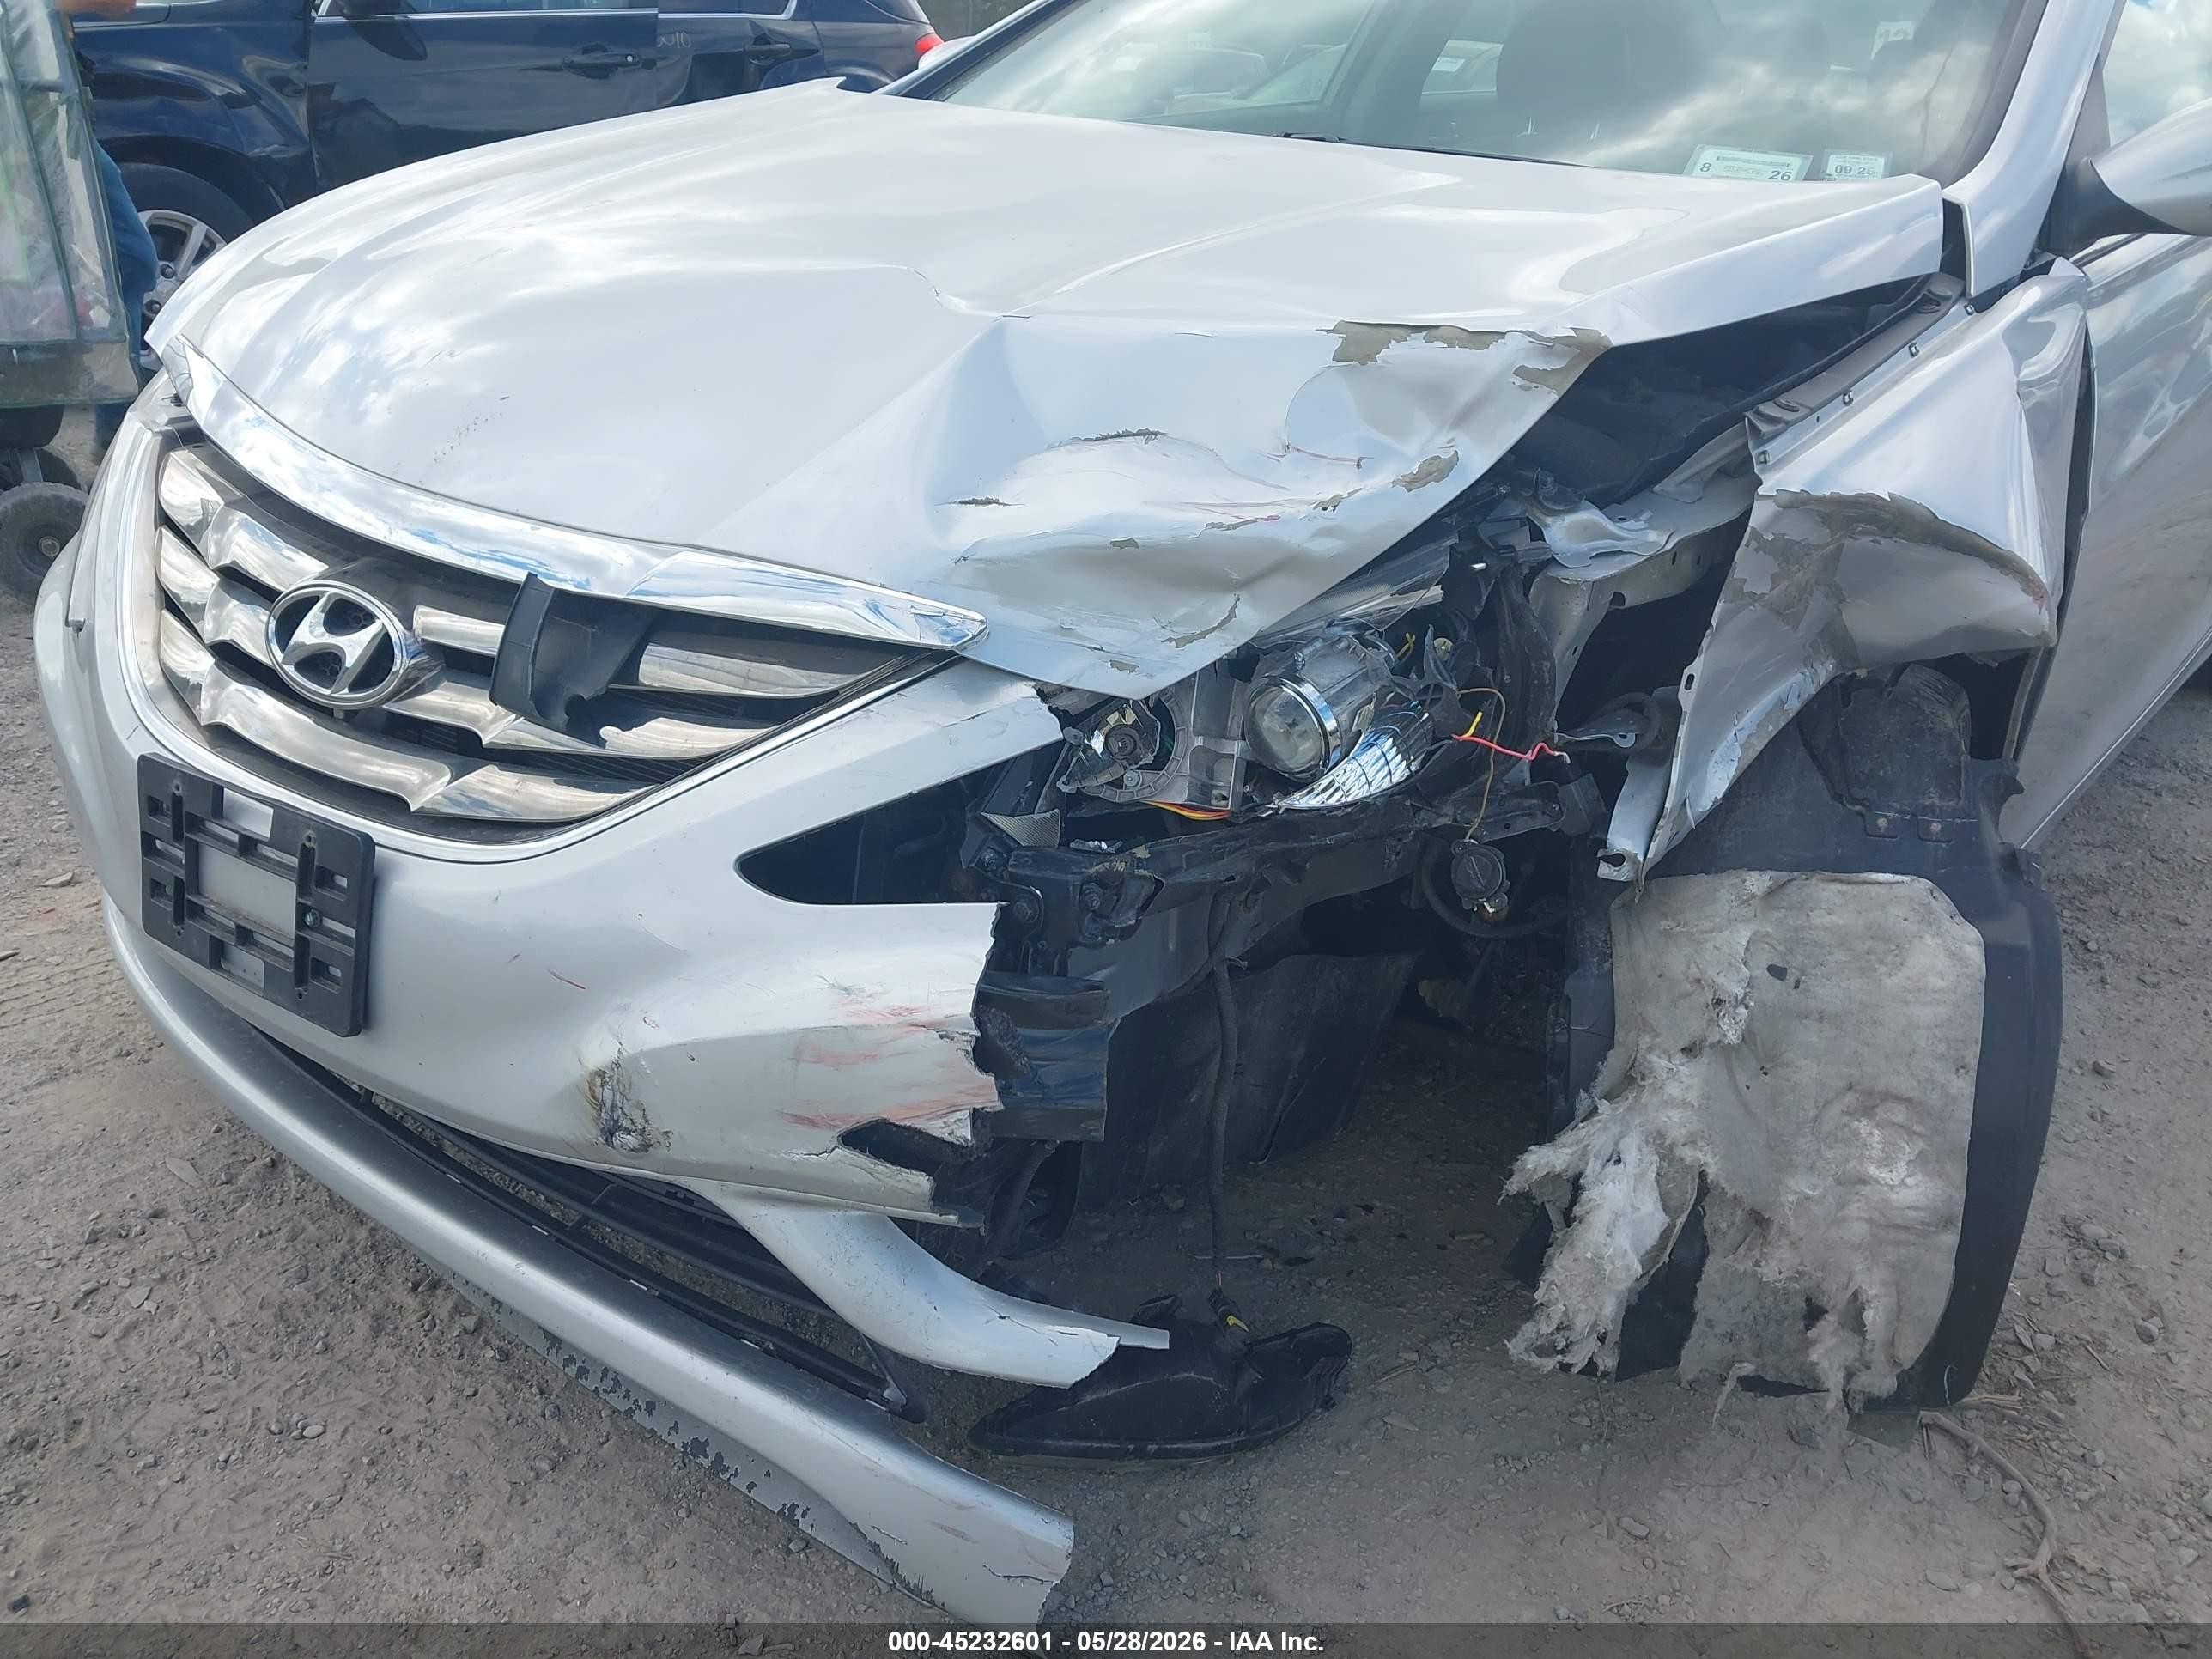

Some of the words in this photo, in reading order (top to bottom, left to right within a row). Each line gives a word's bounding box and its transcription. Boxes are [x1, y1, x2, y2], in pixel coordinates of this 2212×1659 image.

[1699, 161, 1712, 173] 8
[1767, 169, 1793, 181] 26
[1834, 164, 1853, 174] 09
